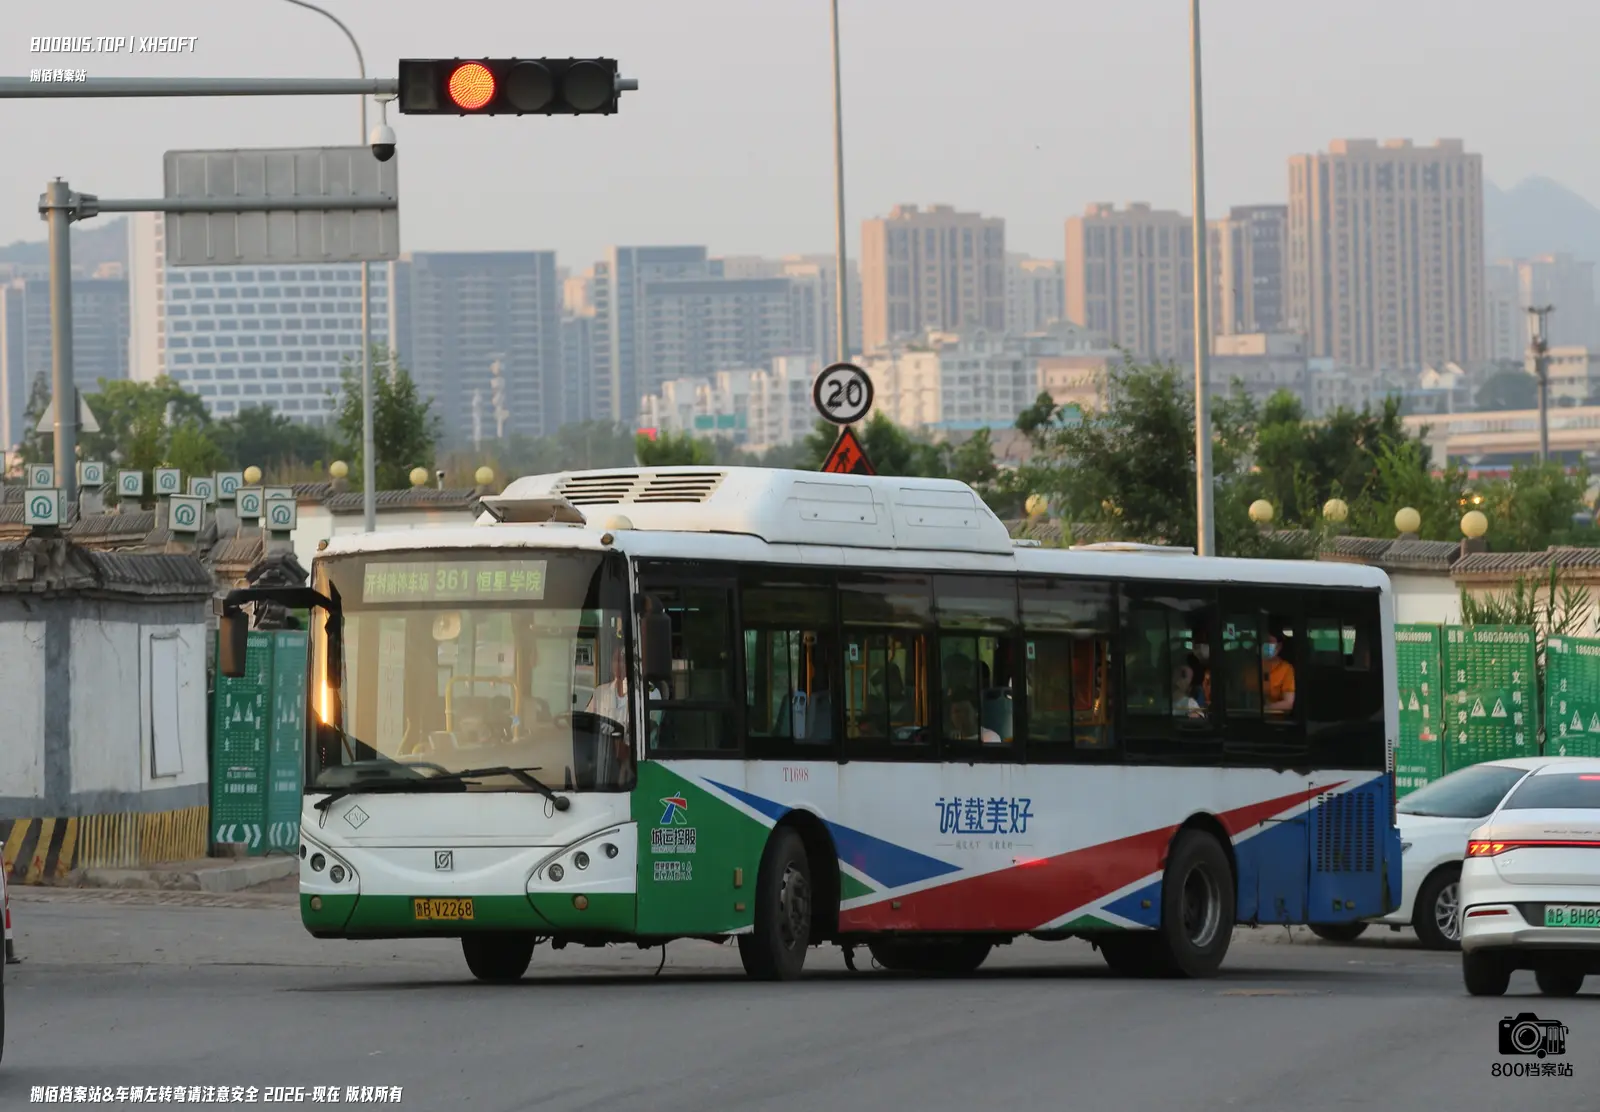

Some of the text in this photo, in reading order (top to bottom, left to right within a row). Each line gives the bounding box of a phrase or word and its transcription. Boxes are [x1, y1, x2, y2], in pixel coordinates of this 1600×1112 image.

[827, 379, 862, 407] 20
[435, 569, 470, 591] 361
[476, 570, 542, 592] 恒星学院
[782, 767, 809, 782] T1698
[935, 797, 1034, 834] 诚载美好
[651, 828, 696, 847] 城运控股
